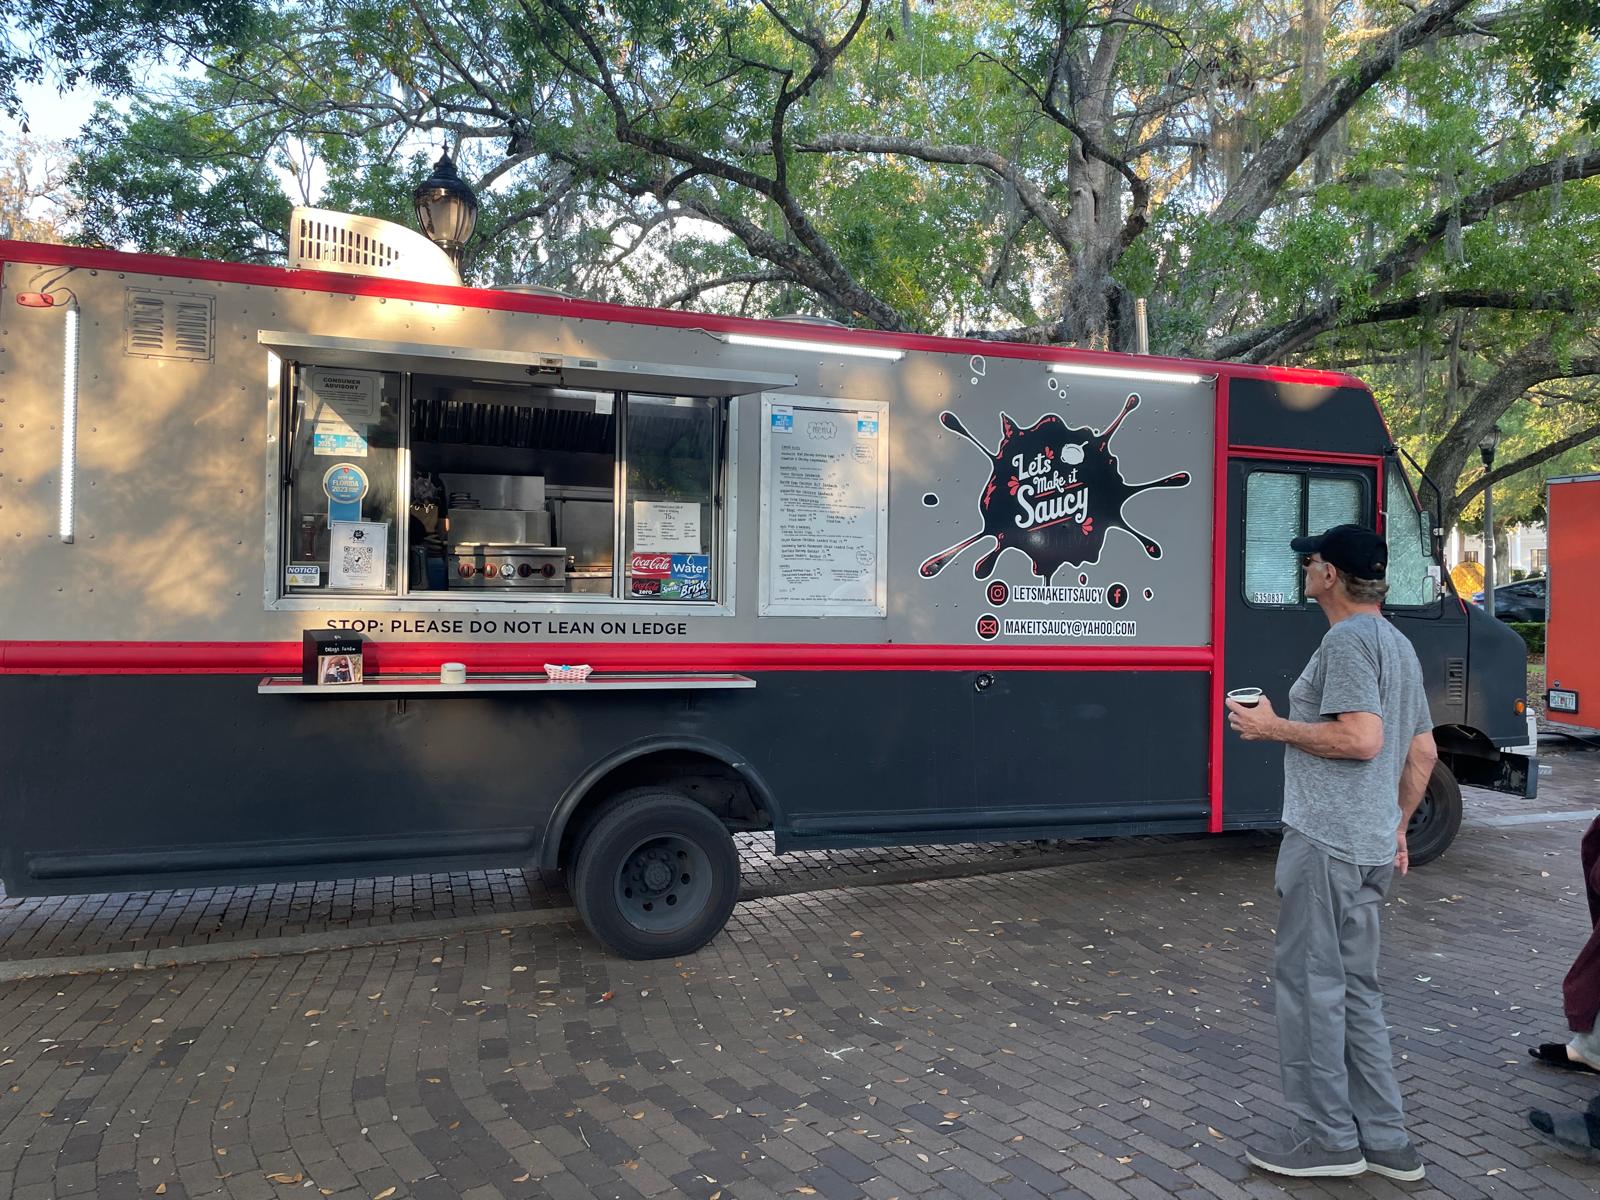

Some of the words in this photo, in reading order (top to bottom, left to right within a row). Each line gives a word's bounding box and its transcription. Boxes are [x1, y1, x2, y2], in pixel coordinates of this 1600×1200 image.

[323, 377, 361, 385] CONSUMER
[1033, 470, 1066, 494] Make
[1068, 468, 1079, 483] it
[1014, 485, 1089, 529] Saucy
[673, 563, 708, 573] Water
[1013, 587, 1104, 603] LETSMAKEITSAUCY
[1254, 593, 1284, 603] 6350837
[391, 620, 463, 633] PLEASE
[470, 620, 497, 634] DO
[503, 621, 542, 634] NOT
[549, 621, 595, 635] LEAN
[601, 622, 626, 635] ON
[632, 622, 687, 635] LEDGE
[1004, 620, 1136, 636] MAKEITSAUCY@YAHOO.COM
